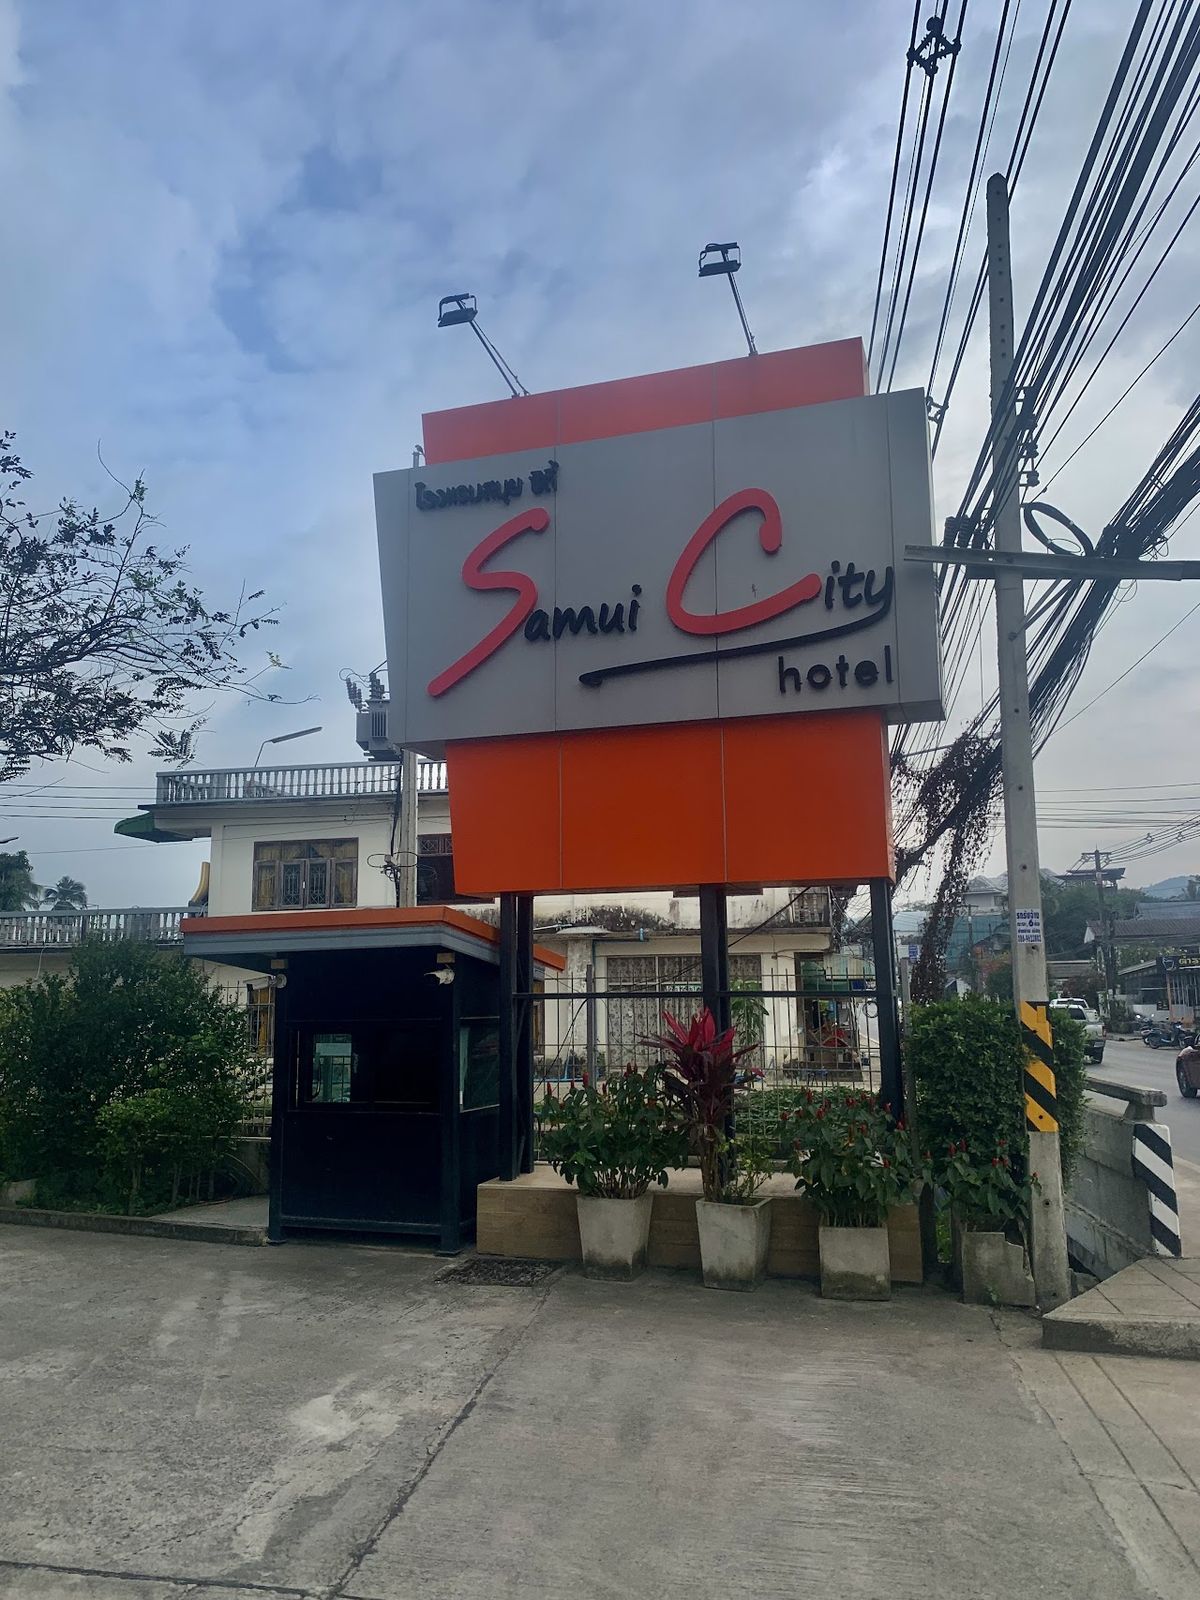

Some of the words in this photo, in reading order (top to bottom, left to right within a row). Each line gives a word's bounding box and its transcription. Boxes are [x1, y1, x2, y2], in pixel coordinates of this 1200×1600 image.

[427, 507, 643, 698] Samui
[667, 488, 894, 637] City
[778, 644, 894, 694] hotel
